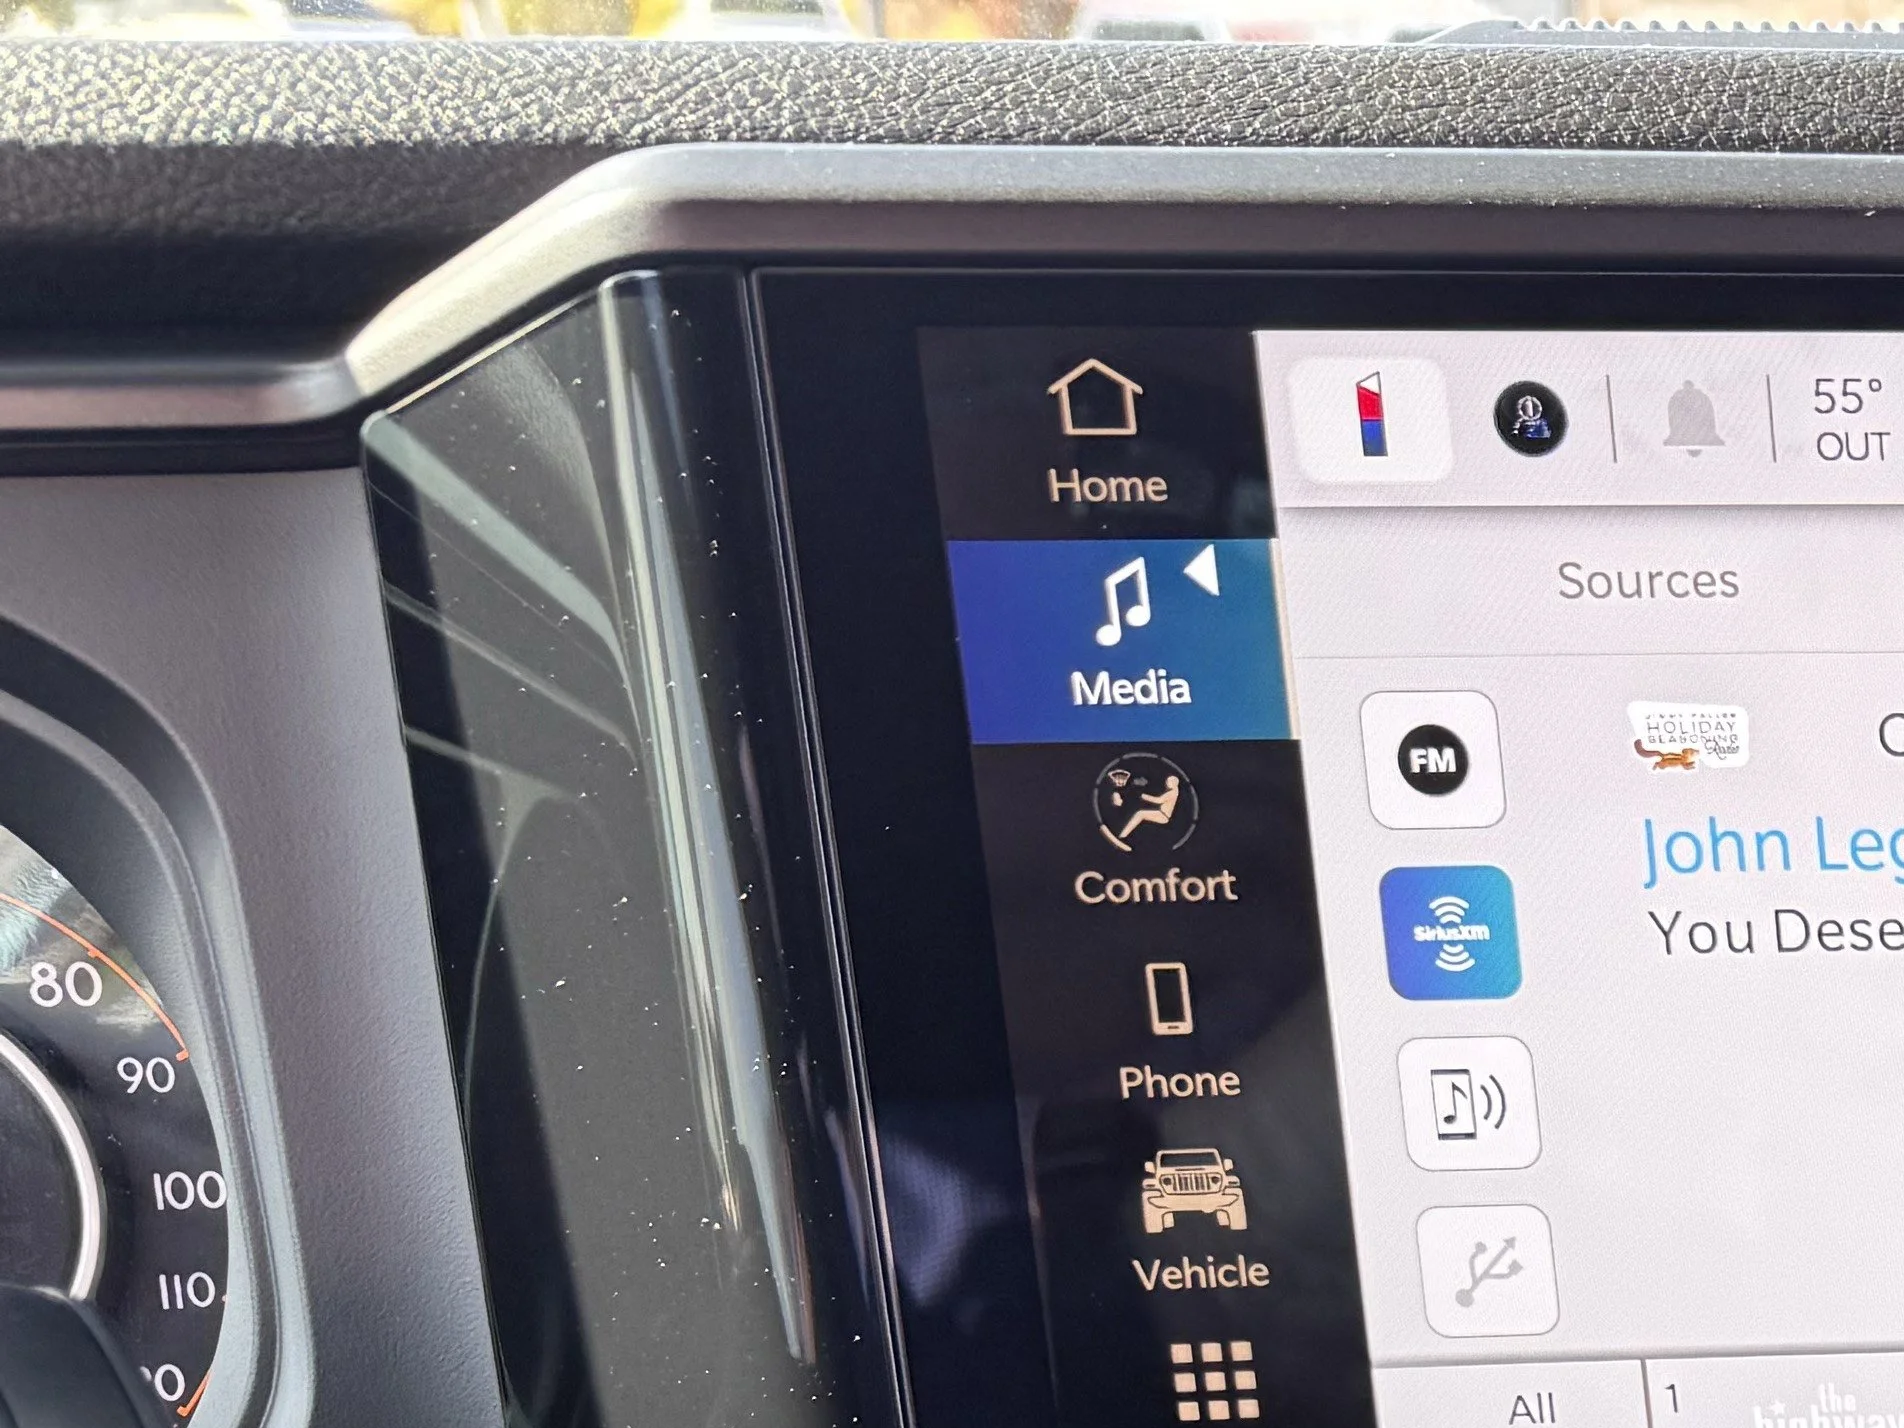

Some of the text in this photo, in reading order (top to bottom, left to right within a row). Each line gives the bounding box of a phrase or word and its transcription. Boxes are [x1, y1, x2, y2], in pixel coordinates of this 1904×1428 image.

[1816, 430, 1891, 462] OUT
[1048, 467, 1168, 505] Home
[1556, 562, 1740, 601] Sources
[1070, 667, 1192, 707] Media
[1646, 721, 1736, 734] HOLIDAY
[1408, 746, 1457, 775] FM
[1642, 816, 1792, 889] John
[1074, 868, 1238, 906] Comfort
[1648, 910, 1755, 956] You
[29, 962, 103, 1009] 80
[116, 1055, 176, 1095] 90
[1119, 1065, 1242, 1099] Phone
[153, 1170, 227, 1210] 100
[159, 1271, 216, 1310] 110
[1132, 1257, 1271, 1291] Vehicle
[1508, 1391, 1557, 1426] All
[1665, 1384, 1682, 1414] 1
[1818, 1381, 1857, 1413] the
